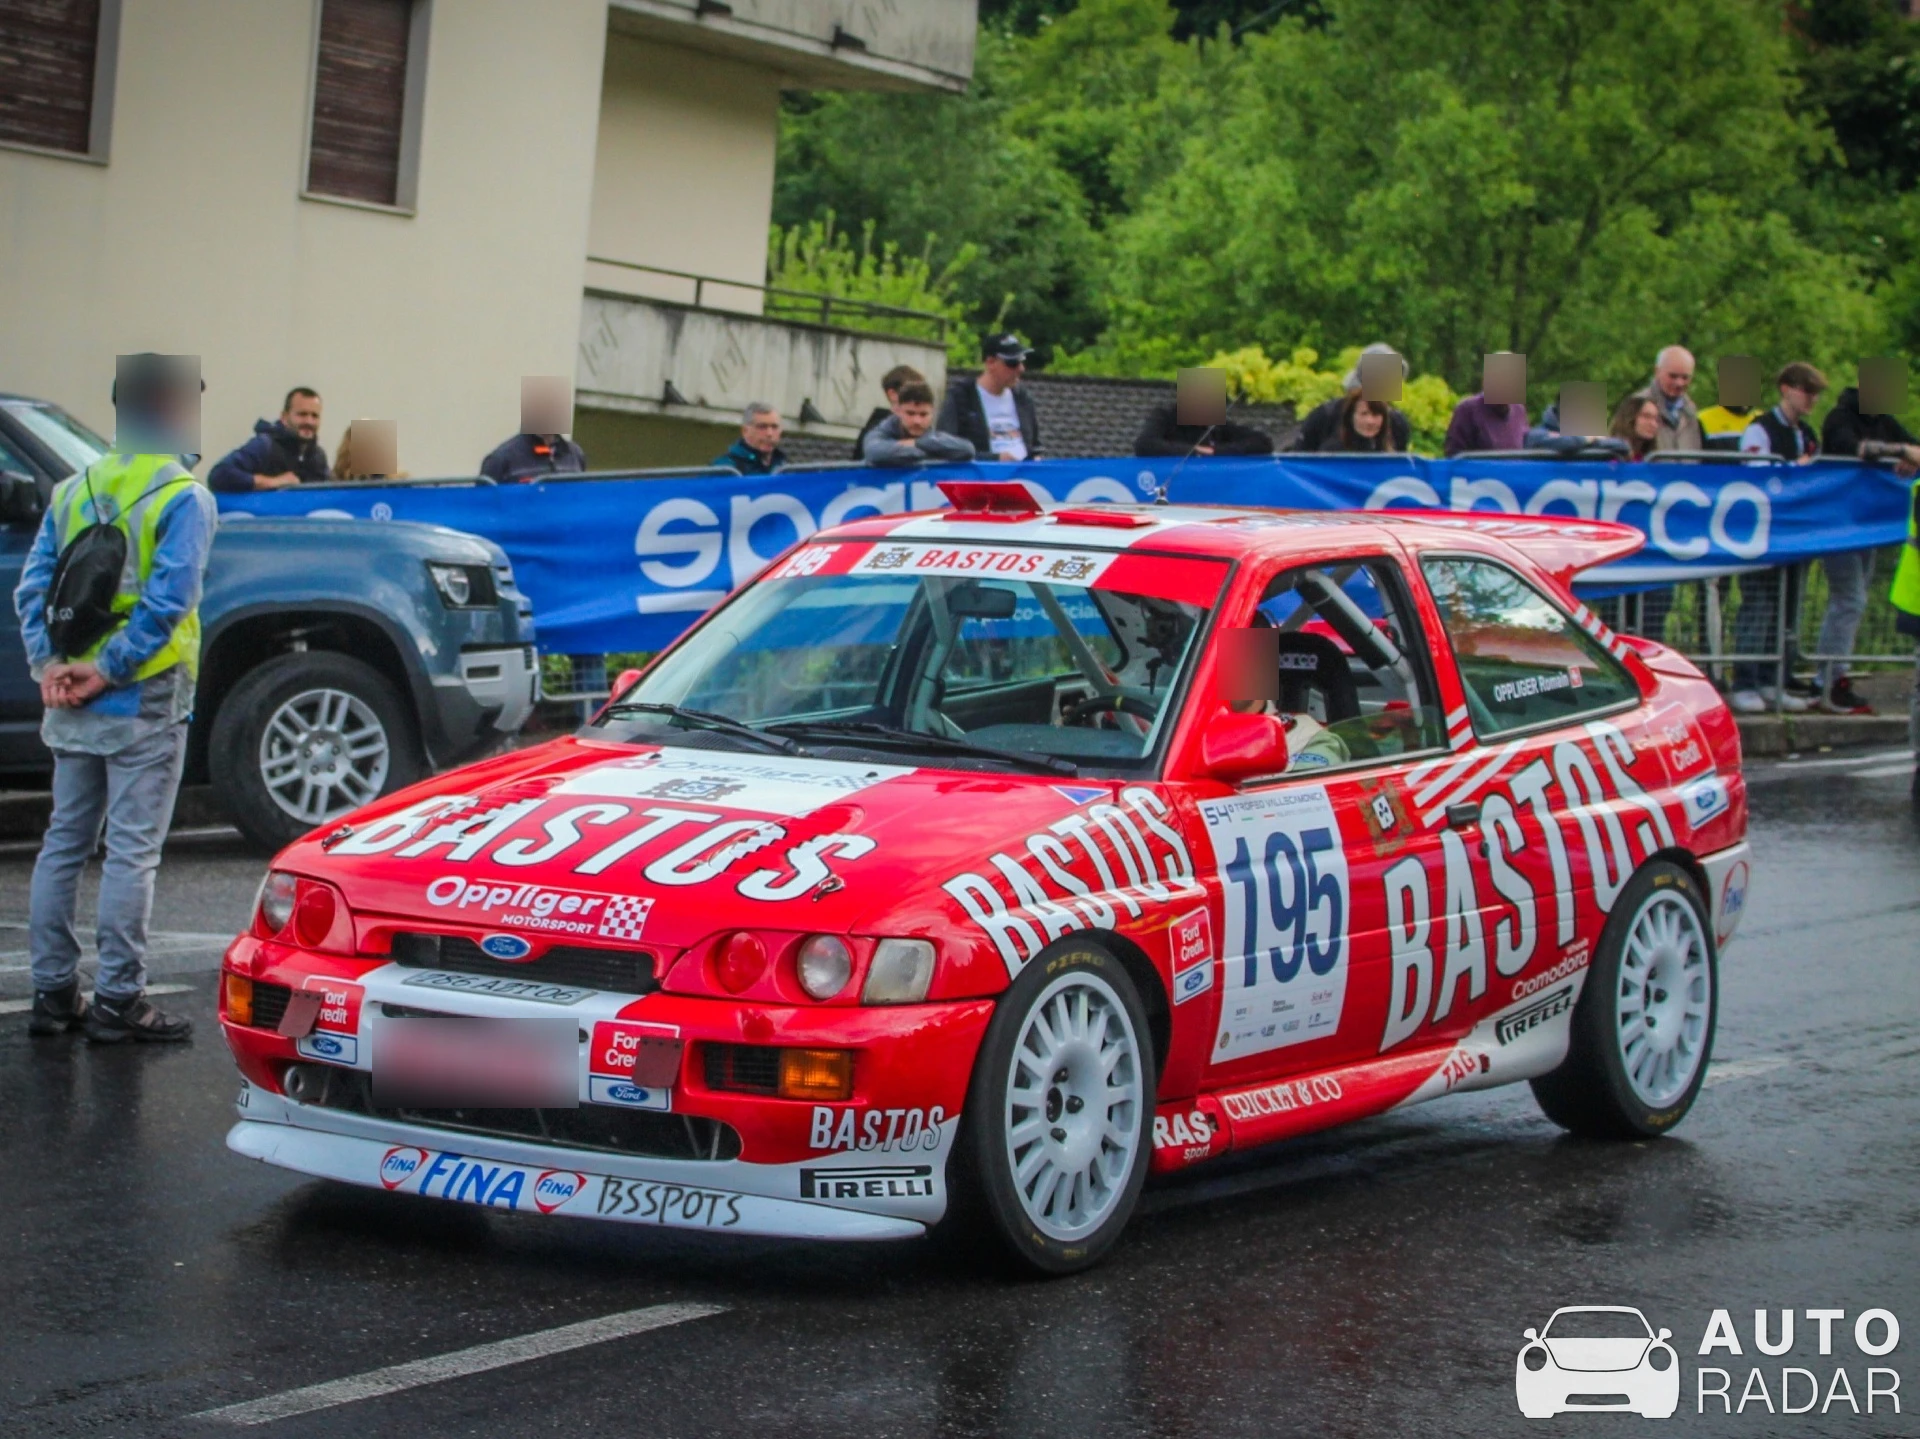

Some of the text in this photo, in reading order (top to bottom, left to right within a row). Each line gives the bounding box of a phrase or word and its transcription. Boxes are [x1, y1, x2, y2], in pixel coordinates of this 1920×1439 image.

[774, 545, 842, 579] 195
[915, 550, 1045, 574] BASTOS
[1494, 677, 1539, 702] OPPLIGER
[327, 794, 877, 902] BASTOS
[426, 875, 604, 917] Oppliger
[942, 787, 1196, 981] BASTOS
[1380, 721, 1676, 1052] BASTOS
[501, 914, 595, 934] MOTORSPORT
[1225, 826, 1343, 989] 195
[1181, 921, 1200, 944] Ford
[1181, 938, 1205, 961] Credit
[1512, 949, 1589, 1001] Cromodora
[533, 987, 581, 1000] 06
[320, 1007, 348, 1025] redit
[1494, 984, 1573, 1047] PIRELLI
[613, 1031, 641, 1050] For
[605, 1048, 637, 1068] Cre
[1223, 1076, 1342, 1121] CRICKET & CO
[809, 1105, 944, 1153] BASTOS
[1152, 1110, 1212, 1149] RAS
[383, 1154, 416, 1173] FINA
[1184, 1144, 1211, 1161] sport
[419, 1151, 526, 1210] FINA
[537, 1178, 574, 1198] FINA
[800, 1165, 932, 1198] PIRELLI
